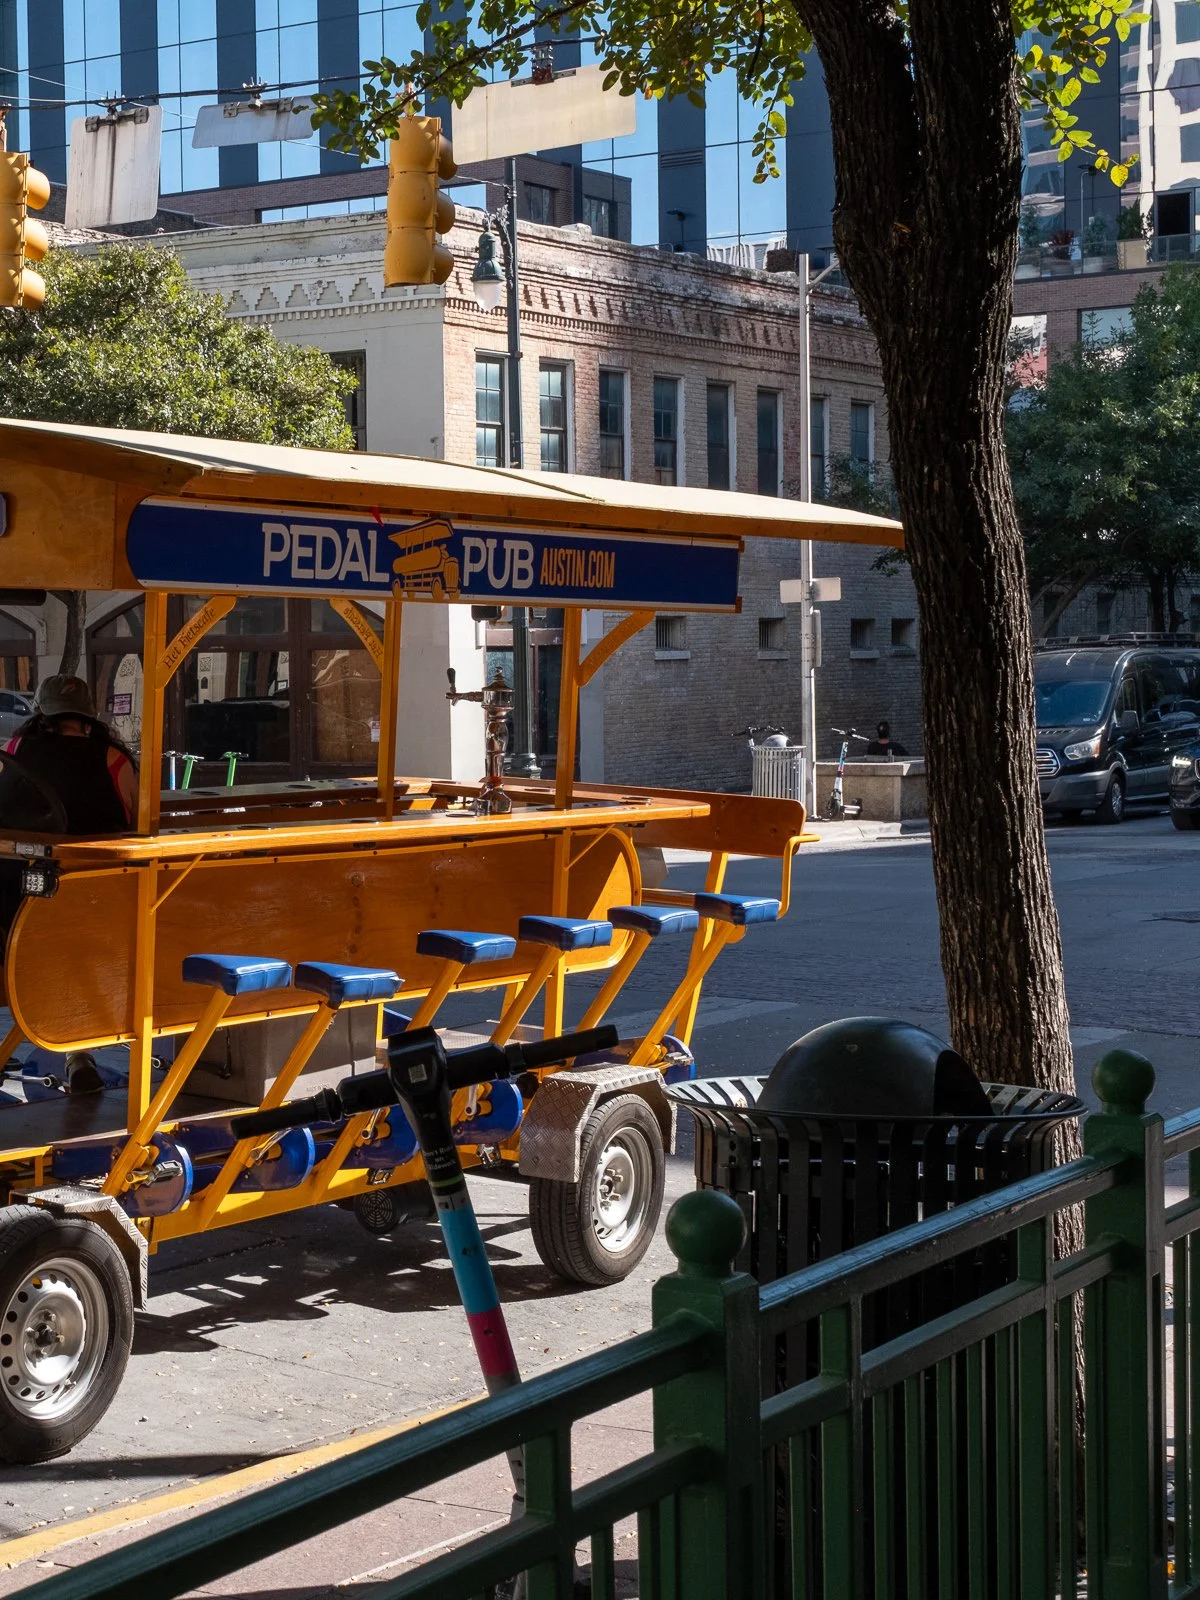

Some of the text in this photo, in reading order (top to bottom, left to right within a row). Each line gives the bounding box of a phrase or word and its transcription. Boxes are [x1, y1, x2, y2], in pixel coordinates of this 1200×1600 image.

[261, 521, 615, 590] PEDAL PUB AUSTIN.COM
[163, 606, 217, 669] Het Fietscafe
